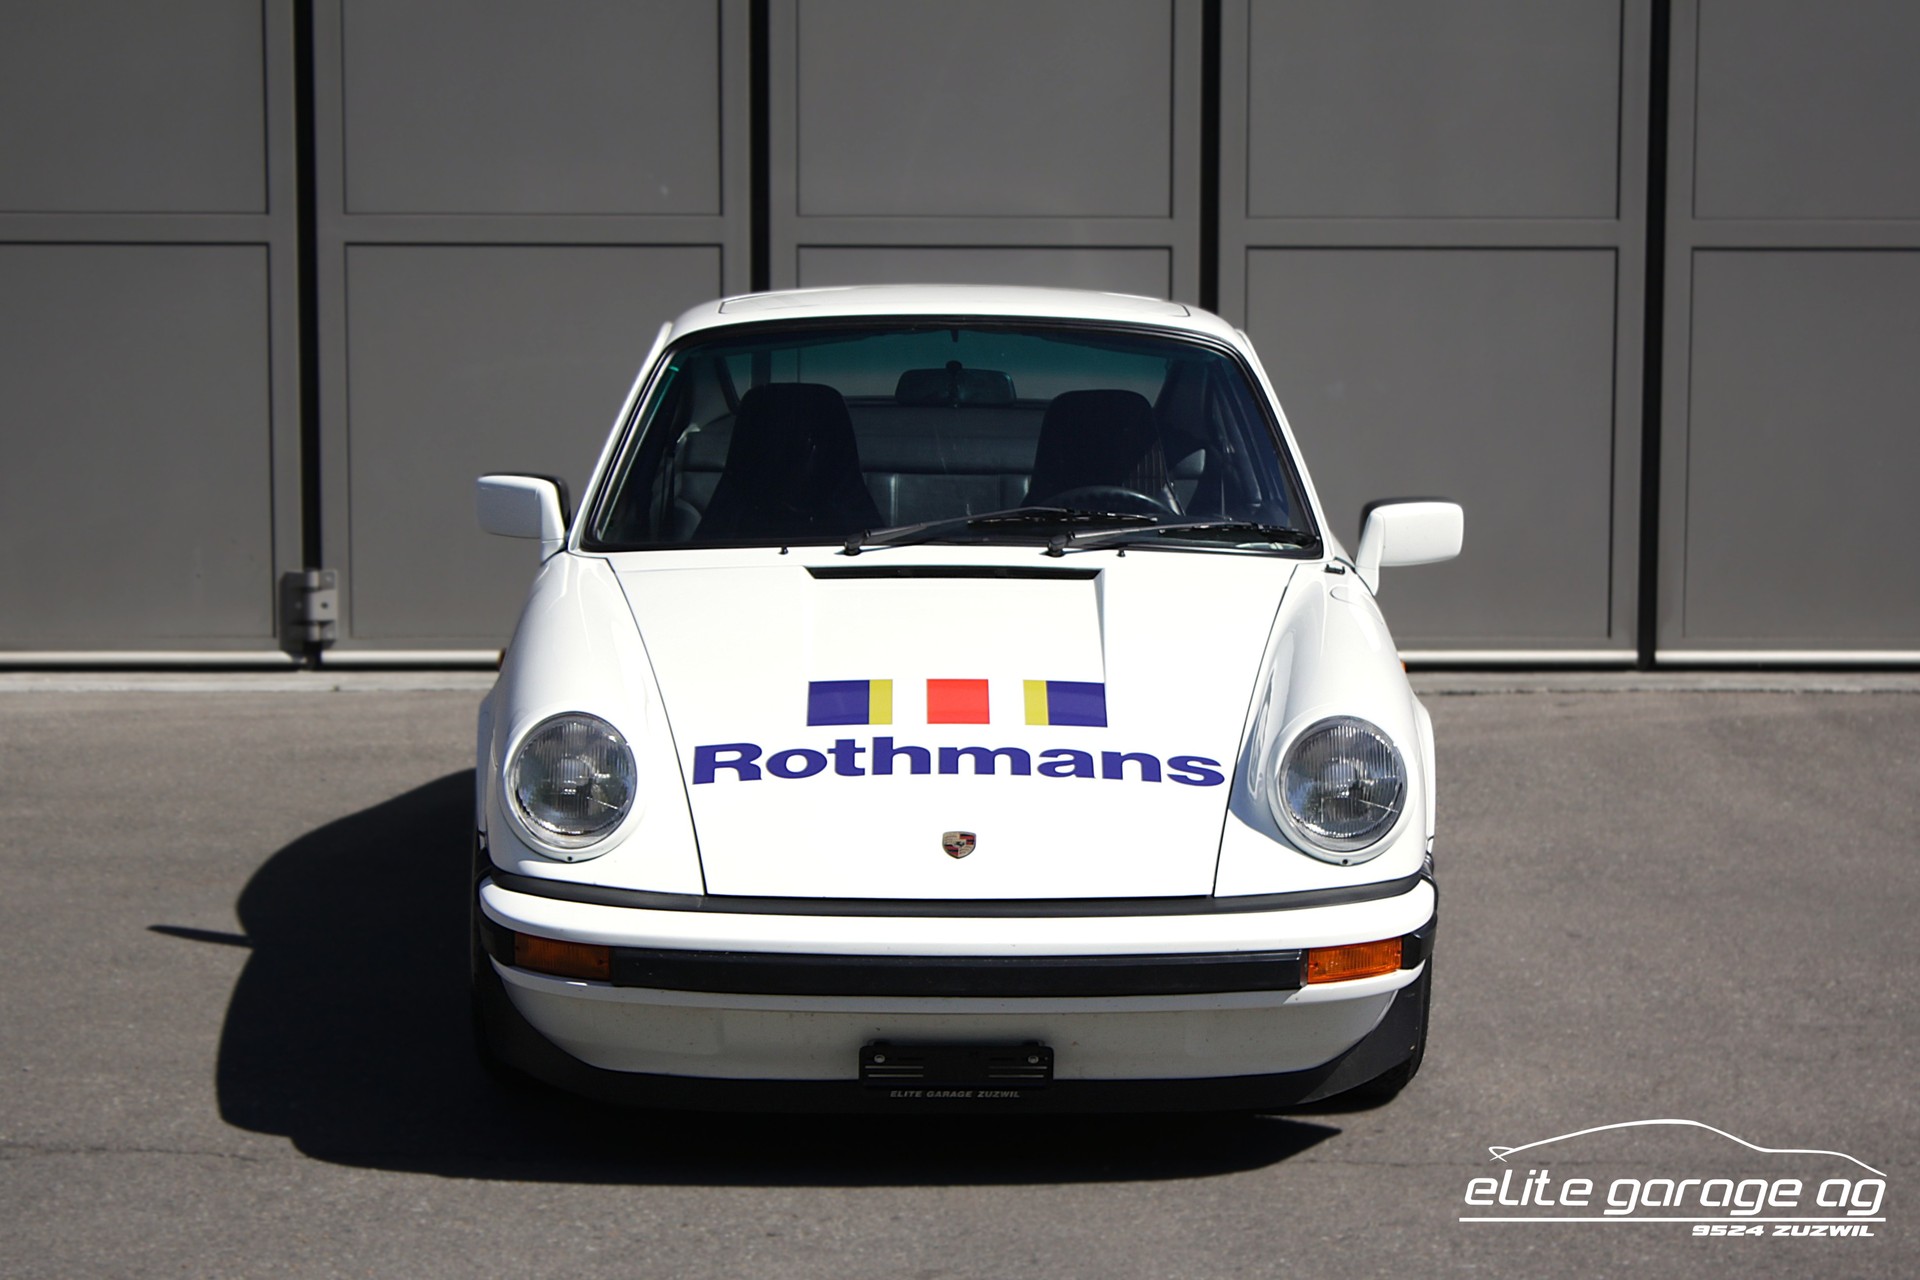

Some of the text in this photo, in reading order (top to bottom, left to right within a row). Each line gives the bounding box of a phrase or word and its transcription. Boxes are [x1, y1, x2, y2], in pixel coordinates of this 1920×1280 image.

[692, 736, 1226, 787] Rothmans
[890, 1090, 1020, 1098] ELITE GARAGE ZUZWIL
